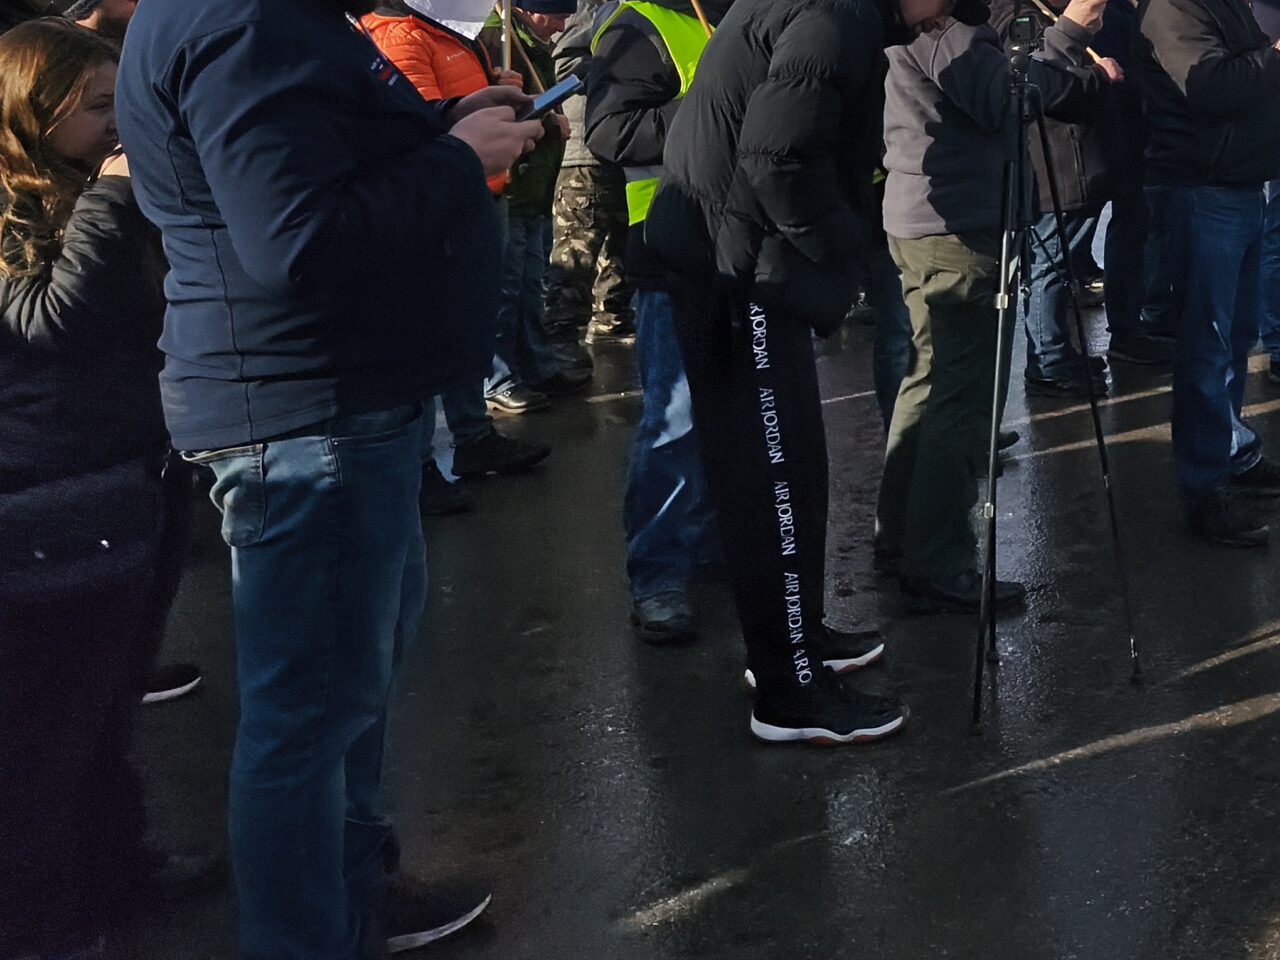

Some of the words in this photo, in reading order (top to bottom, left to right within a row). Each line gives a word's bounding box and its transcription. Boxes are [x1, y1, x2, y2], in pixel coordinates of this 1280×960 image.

[749, 314, 770, 370] JORDAN
[761, 410, 785, 464] JORDAN
[774, 503, 796, 556] JORDAN
